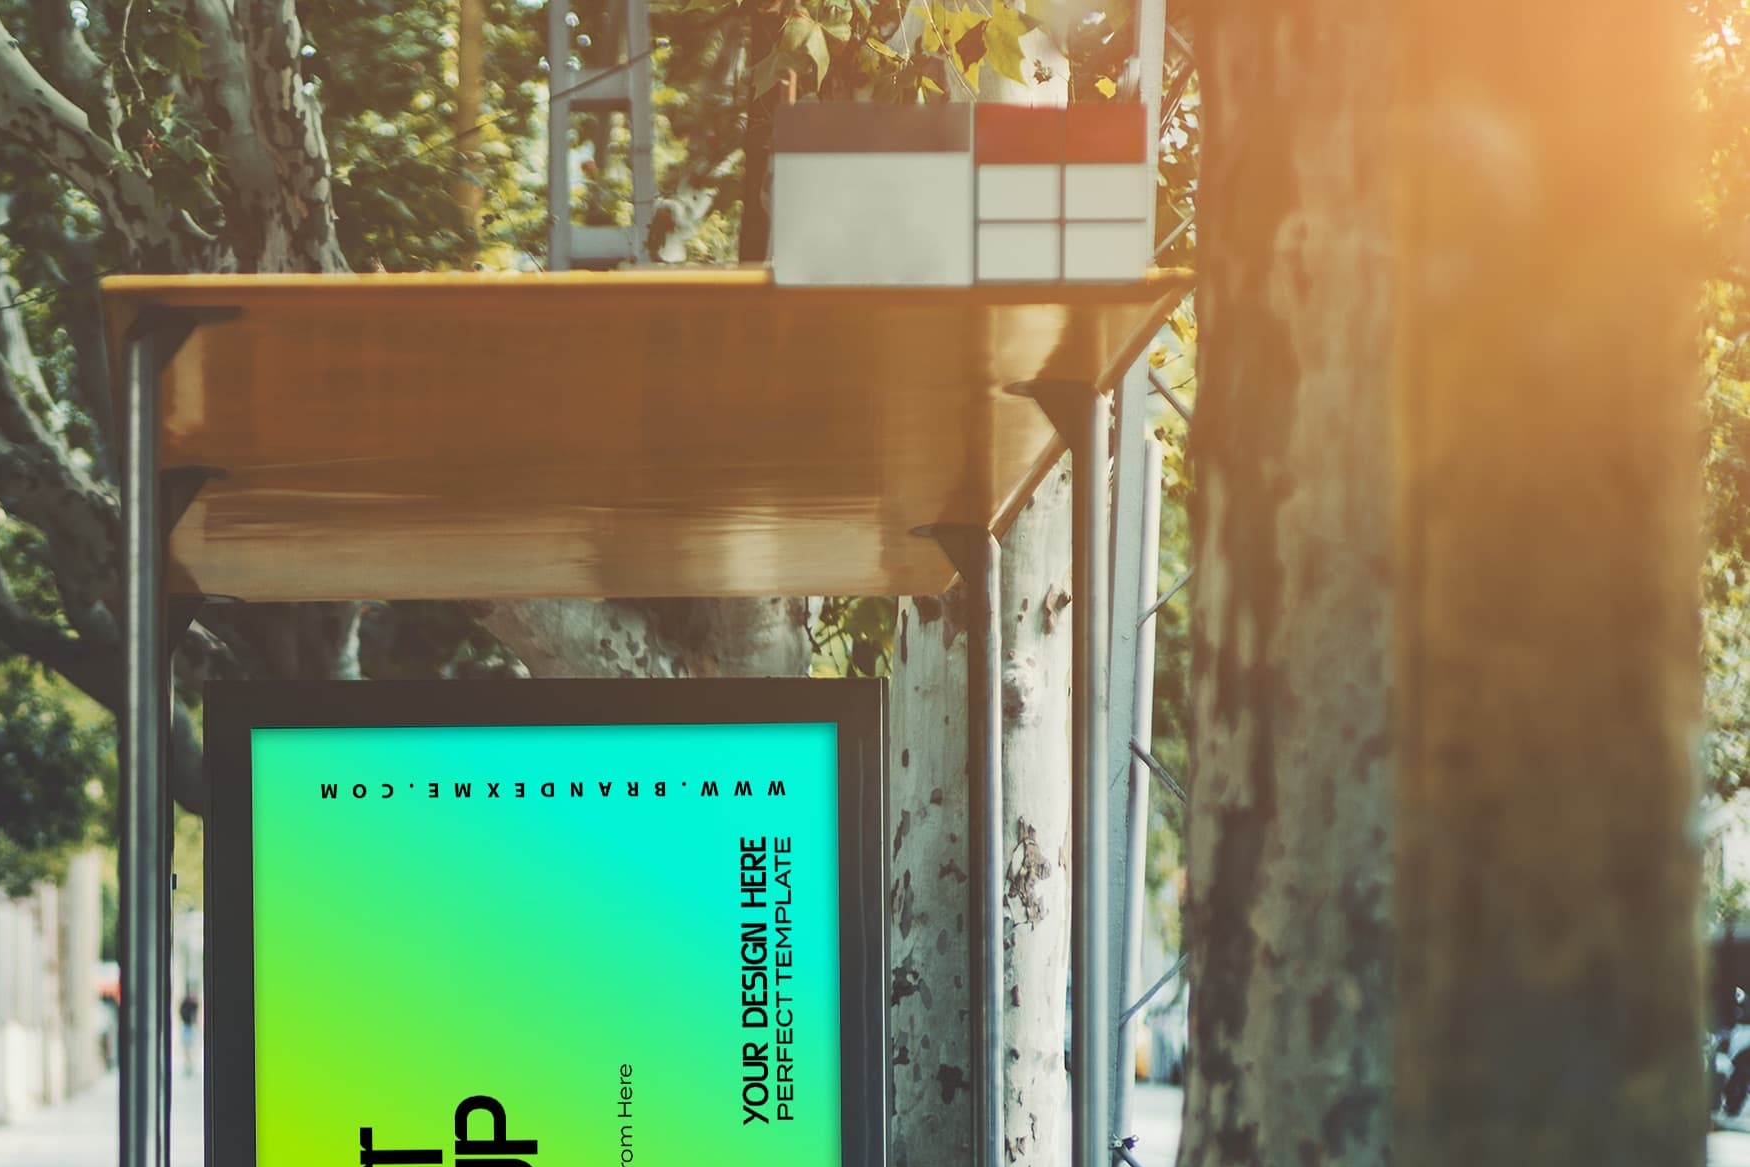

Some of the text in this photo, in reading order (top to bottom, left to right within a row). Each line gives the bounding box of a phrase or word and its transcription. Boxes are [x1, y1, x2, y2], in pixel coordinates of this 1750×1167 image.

[319, 780, 787, 799] WWW.BRANDEXME.COM
[739, 836, 770, 1126] YOUR DESIGN HERE
[773, 836, 794, 1122] PERFECT TEMPLATE
[617, 1063, 633, 1119] Here
